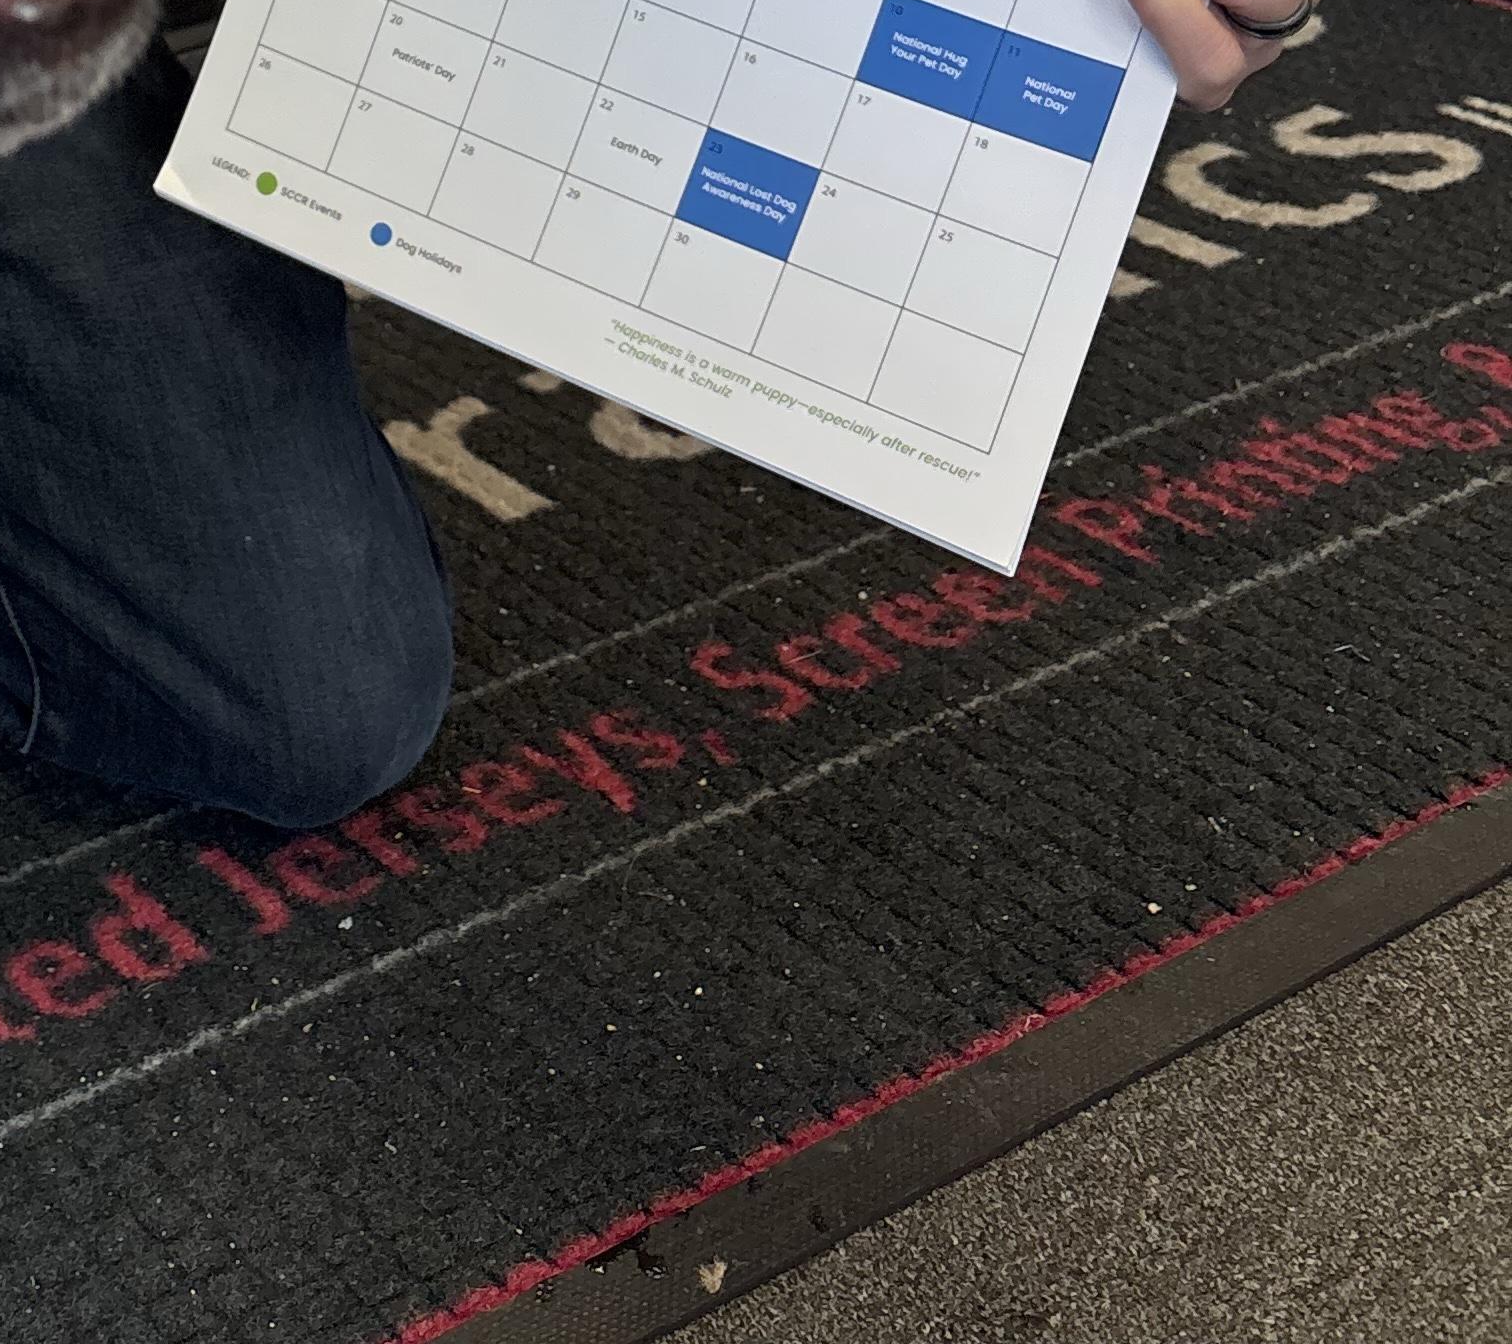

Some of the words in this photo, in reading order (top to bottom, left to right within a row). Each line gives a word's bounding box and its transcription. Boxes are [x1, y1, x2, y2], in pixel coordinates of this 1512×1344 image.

[634, 10, 646, 22] 15
[890, 3, 904, 16] 10
[389, 14, 403, 26] 20
[892, 31, 943, 57] National
[944, 49, 969, 68] Hug
[1007, 45, 1021, 58] 11
[259, 58, 272, 71] 26
[493, 55, 506, 68] 21
[744, 52, 757, 64] 16
[889, 44, 917, 63] Your
[918, 54, 938, 70] Pet
[939, 61, 963, 79] Day
[434, 65, 457, 82] Day
[1024, 75, 1077, 101] National
[358, 100, 372, 112] 27
[599, 98, 614, 112] 22
[857, 94, 872, 107] 17
[1022, 89, 1043, 105] Pet
[1043, 96, 1069, 115] Day
[460, 143, 475, 156] 28
[708, 141, 723, 155] 23
[974, 136, 989, 150] 18
[610, 136, 640, 156] Earth
[641, 147, 663, 166] Day
[212, 155, 251, 181] LEGEND:
[565, 187, 581, 201] 29
[701, 165, 749, 192] National
[749, 183, 773, 203] Lost
[773, 193, 798, 213] Dog
[821, 185, 837, 199] 24
[280, 186, 309, 207] SCCR
[309, 198, 342, 221] Events
[701, 182, 763, 214] Awareness
[763, 205, 788, 225] Day
[673, 231, 690, 245] 30
[938, 230, 954, 243] 25
[395, 237, 417, 257] Dog
[418, 246, 463, 274] Holidays
[618, 340, 668, 372] Charles
[670, 363, 689, 379] M.
[688, 370, 734, 399] Schulz
[685, 350, 697, 364] is
[699, 358, 710, 370] a
[712, 363, 751, 388] warm
[880, 432, 917, 458] after
[197, 709, 737, 937] Jerseys,
[691, 544, 1102, 723] Screen
